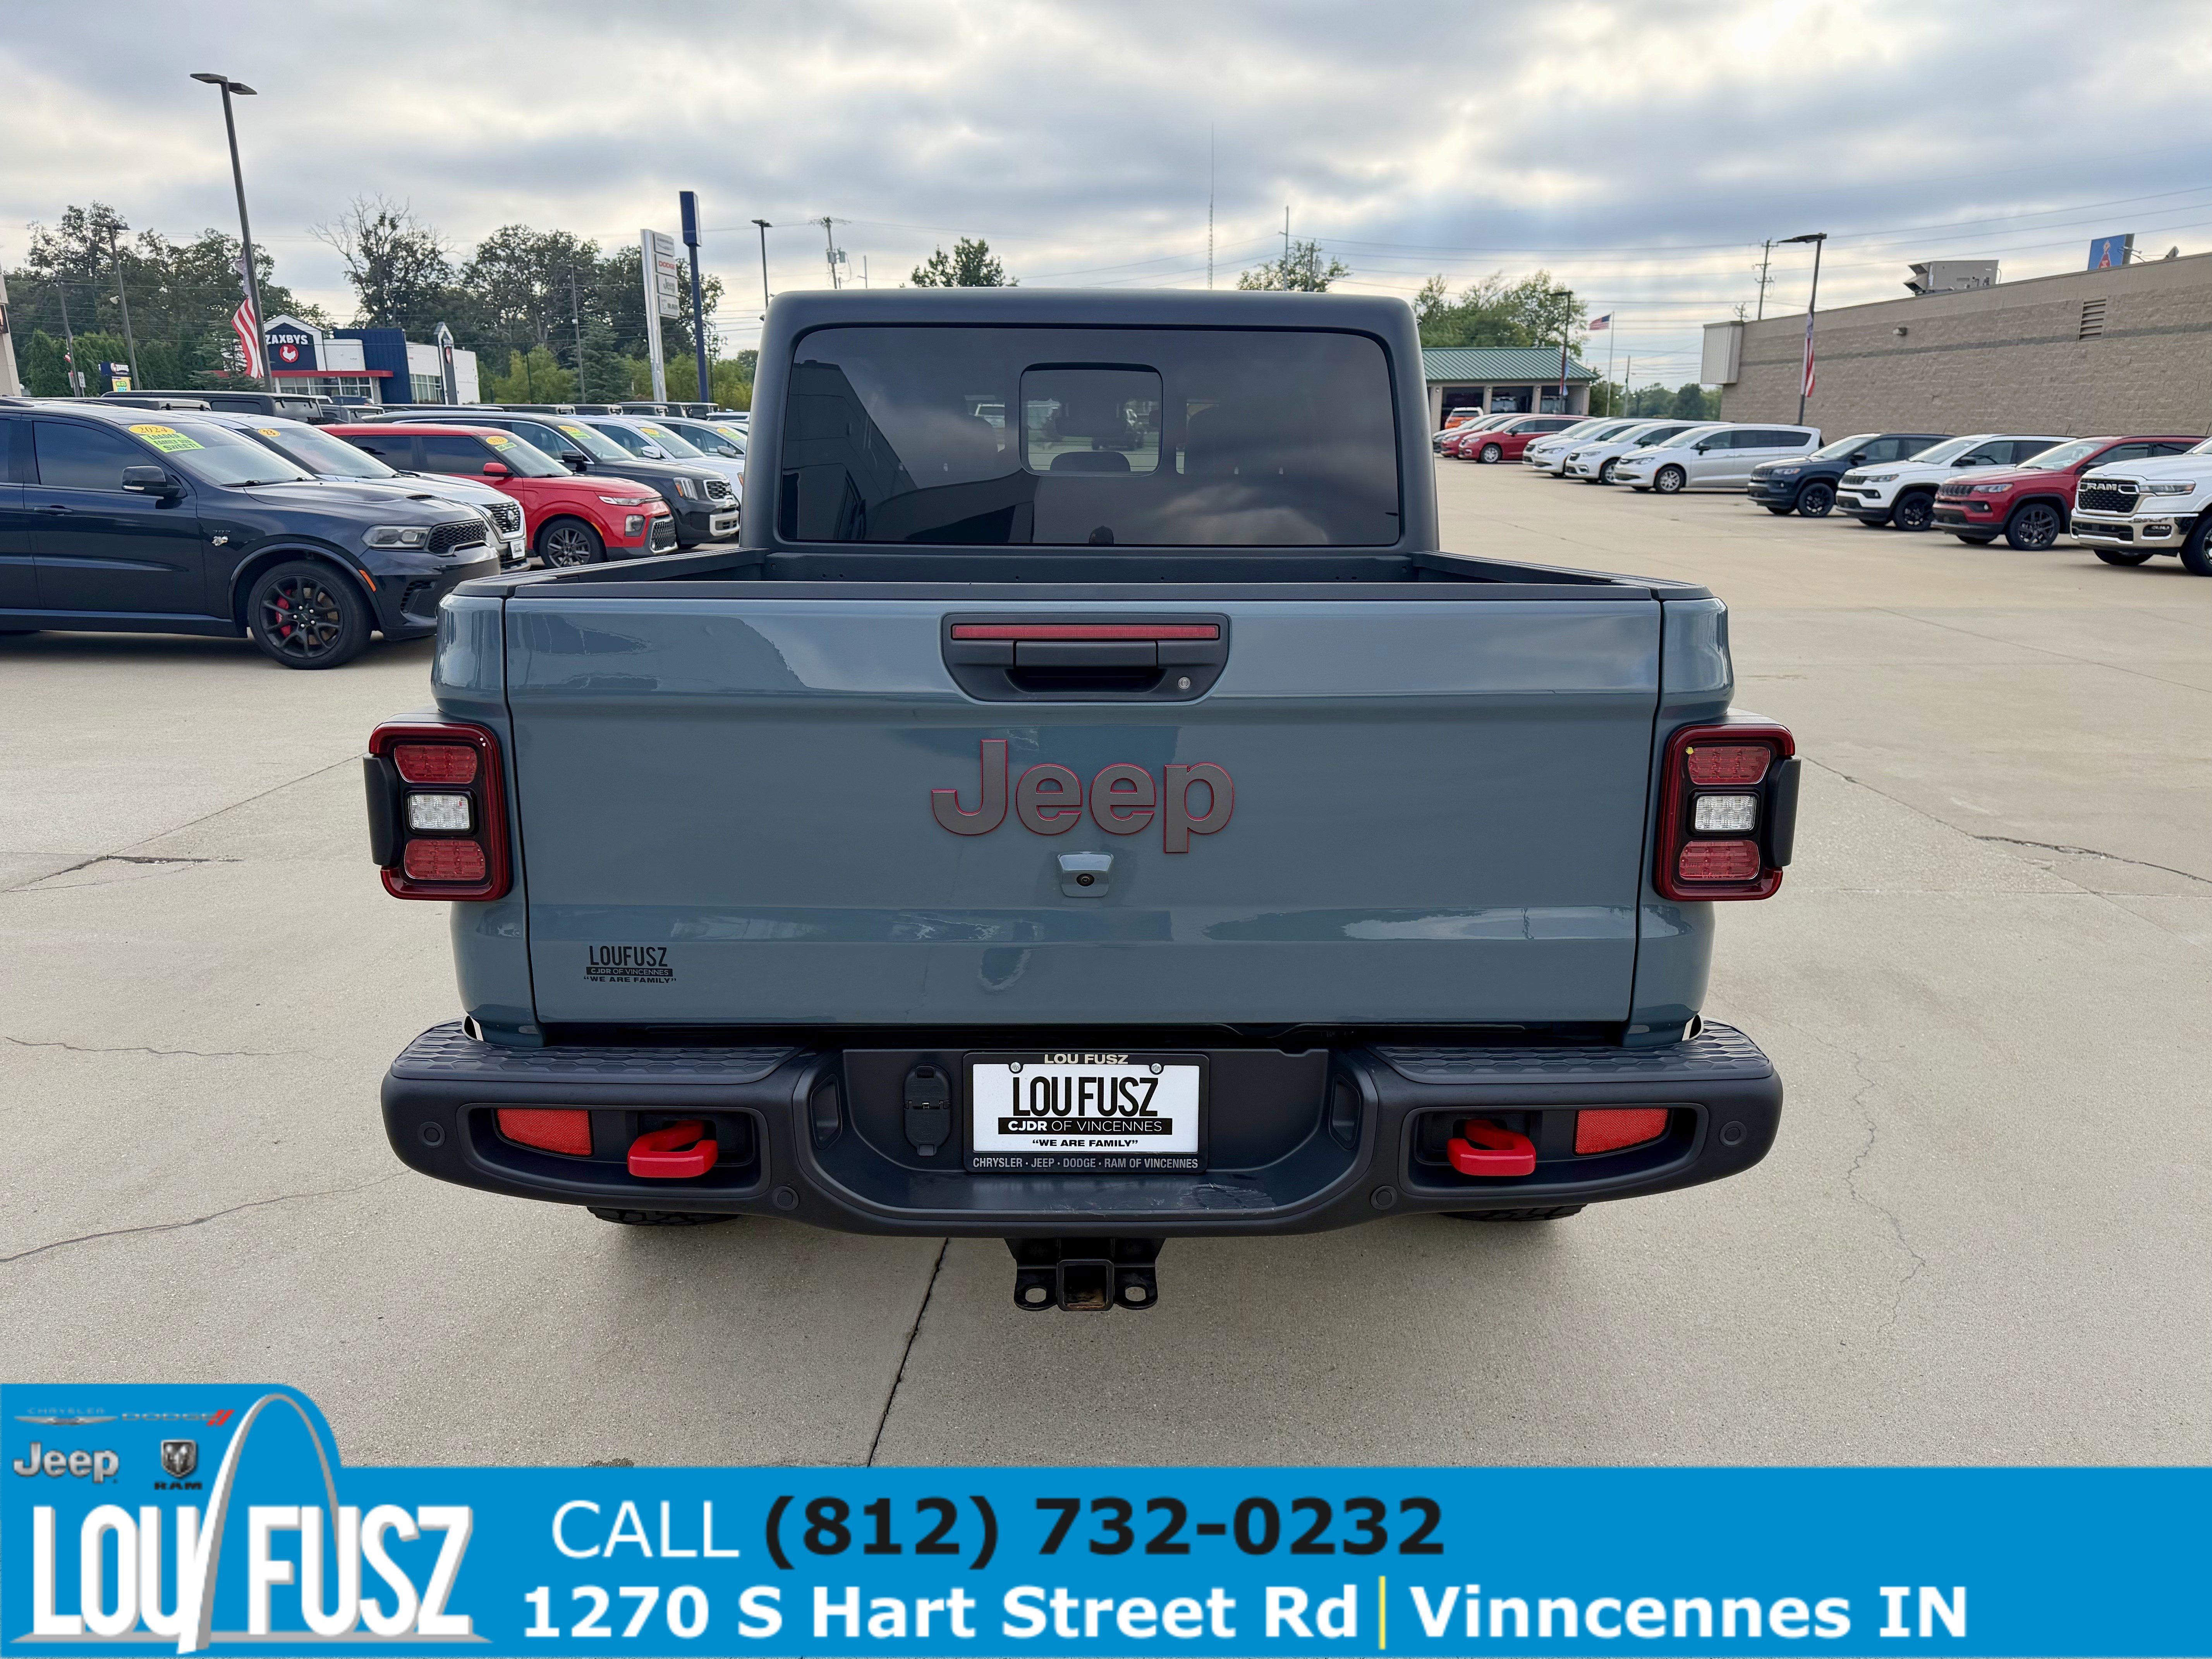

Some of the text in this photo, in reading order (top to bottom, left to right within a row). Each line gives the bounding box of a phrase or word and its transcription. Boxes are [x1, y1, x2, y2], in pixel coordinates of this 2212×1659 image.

[265, 335, 308, 345] ZAXBYS
[931, 739, 1235, 854] Jeep
[1044, 1054, 1128, 1065] LOU FUSZ
[1013, 1076, 1158, 1116] LOU FUSZ
[1008, 1121, 1162, 1132] CJDR OF VINCENNES
[973, 1158, 1198, 1168] CHRYSLER JEEP DODGE RAM OF VINCENNES
